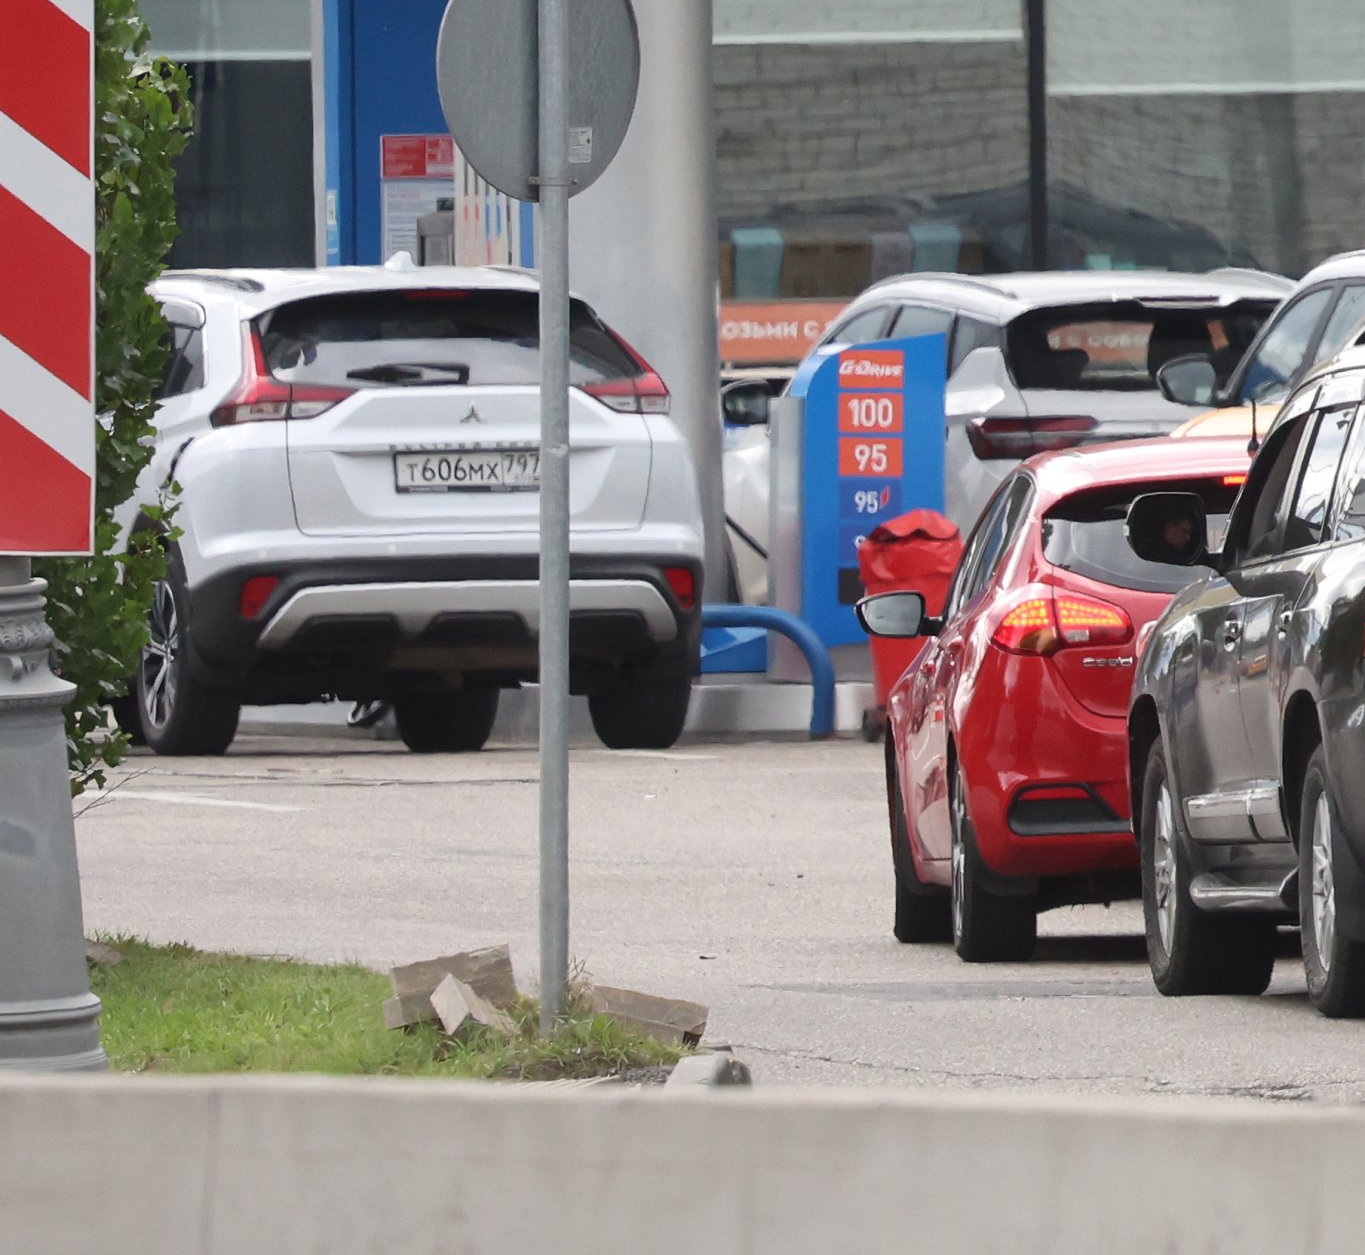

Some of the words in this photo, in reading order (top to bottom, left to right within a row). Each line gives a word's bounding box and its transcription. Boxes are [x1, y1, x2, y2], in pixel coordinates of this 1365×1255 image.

[847, 397, 894, 428] 100
[854, 443, 888, 473] 95
[853, 490, 880, 515] 95
